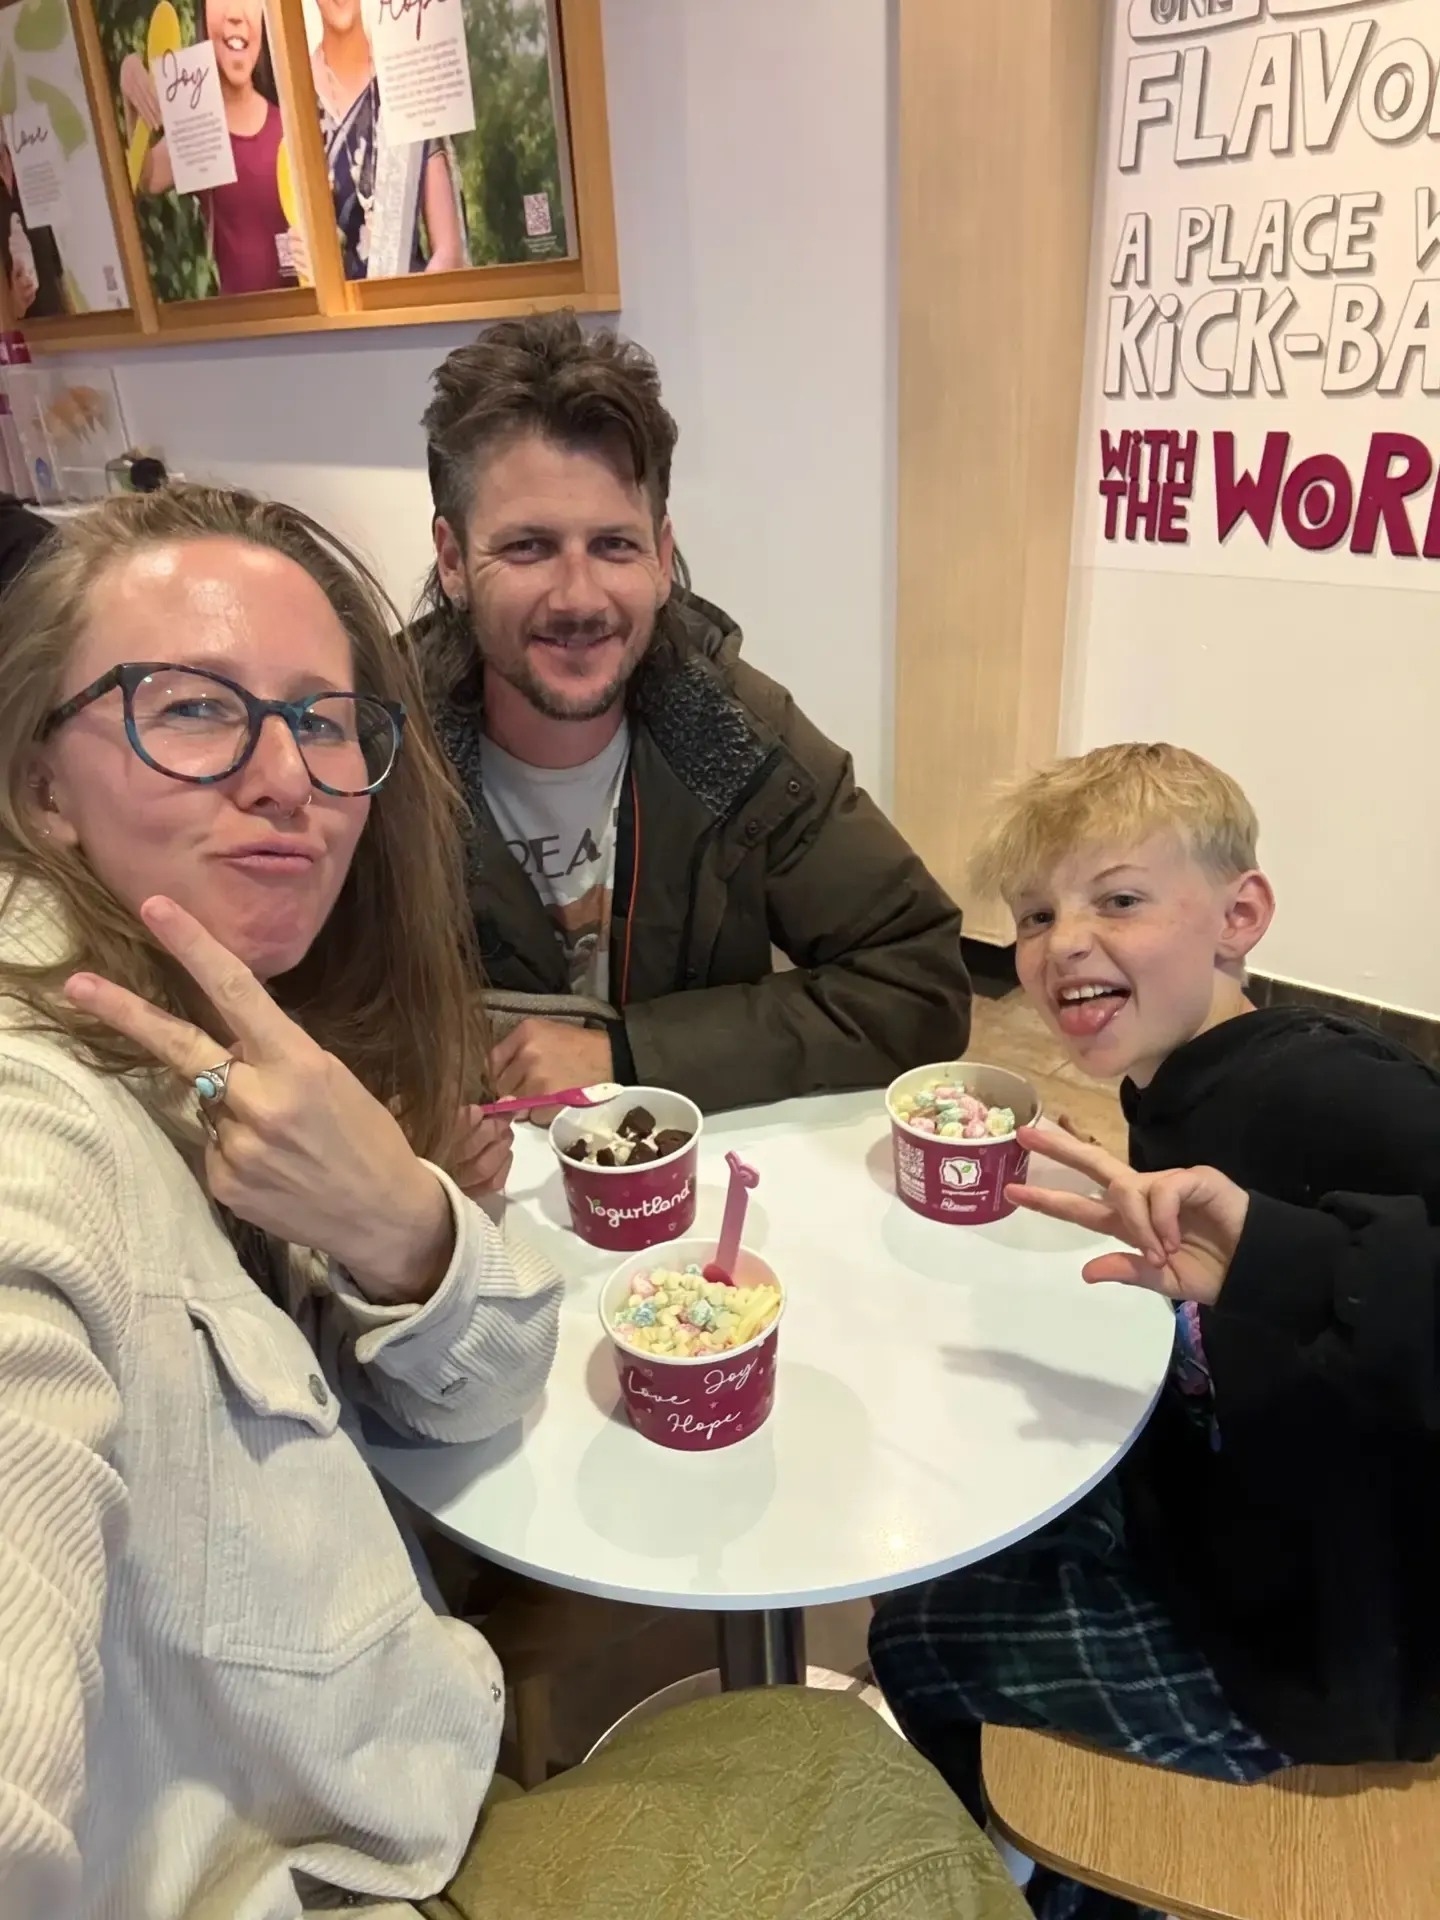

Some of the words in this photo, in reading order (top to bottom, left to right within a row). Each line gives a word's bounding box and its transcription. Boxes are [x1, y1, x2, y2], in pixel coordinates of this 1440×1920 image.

[379, 0, 447, 41] Hop
[162, 48, 210, 110] Joy
[1118, 19, 1440, 173] FLAVO
[1110, 212, 1150, 288] A
[1175, 191, 1384, 286] PLACE
[1099, 479, 1193, 543] THE
[1213, 431, 1440, 560] WOR
[585, 1179, 692, 1228] Yogurtland
[628, 1370, 691, 1405] Love
[704, 1357, 759, 1395] Joy
[667, 1411, 741, 1440] Hope
